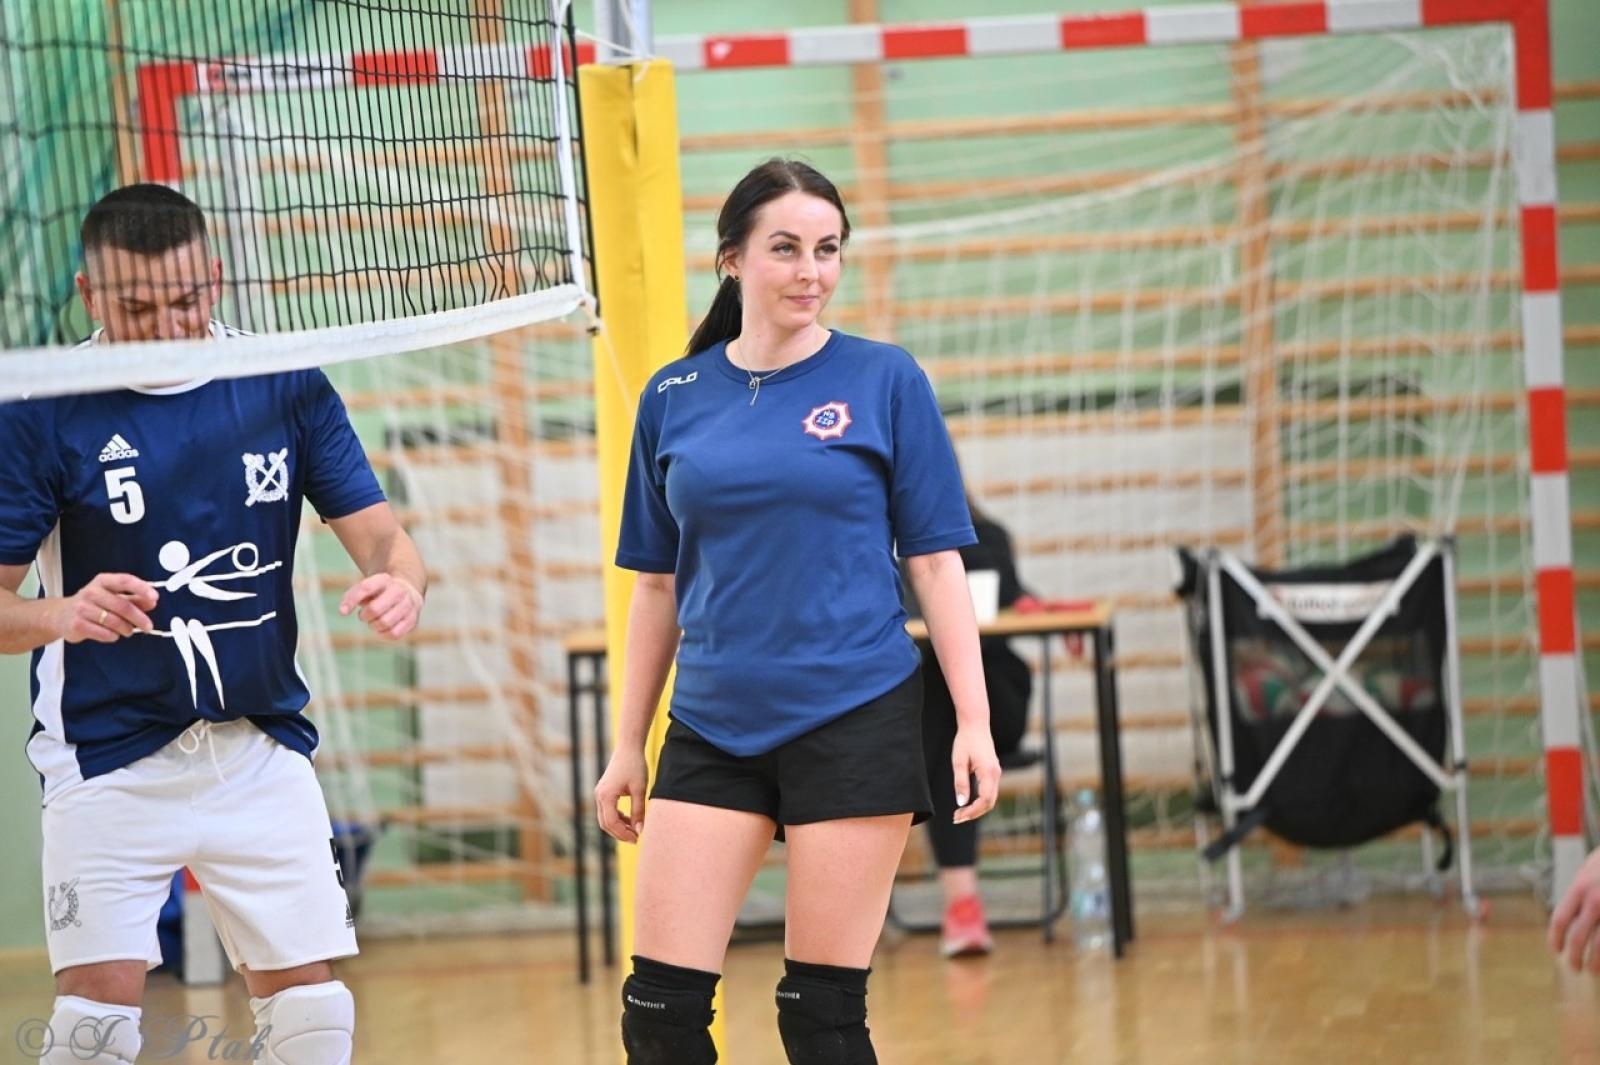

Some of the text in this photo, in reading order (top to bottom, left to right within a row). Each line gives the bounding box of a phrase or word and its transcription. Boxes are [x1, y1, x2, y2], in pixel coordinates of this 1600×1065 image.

[98, 448, 140, 463] adidas
[104, 466, 146, 525] 5
[776, 991, 800, 1000] ANTHER
[634, 997, 667, 1010] PANTHER
